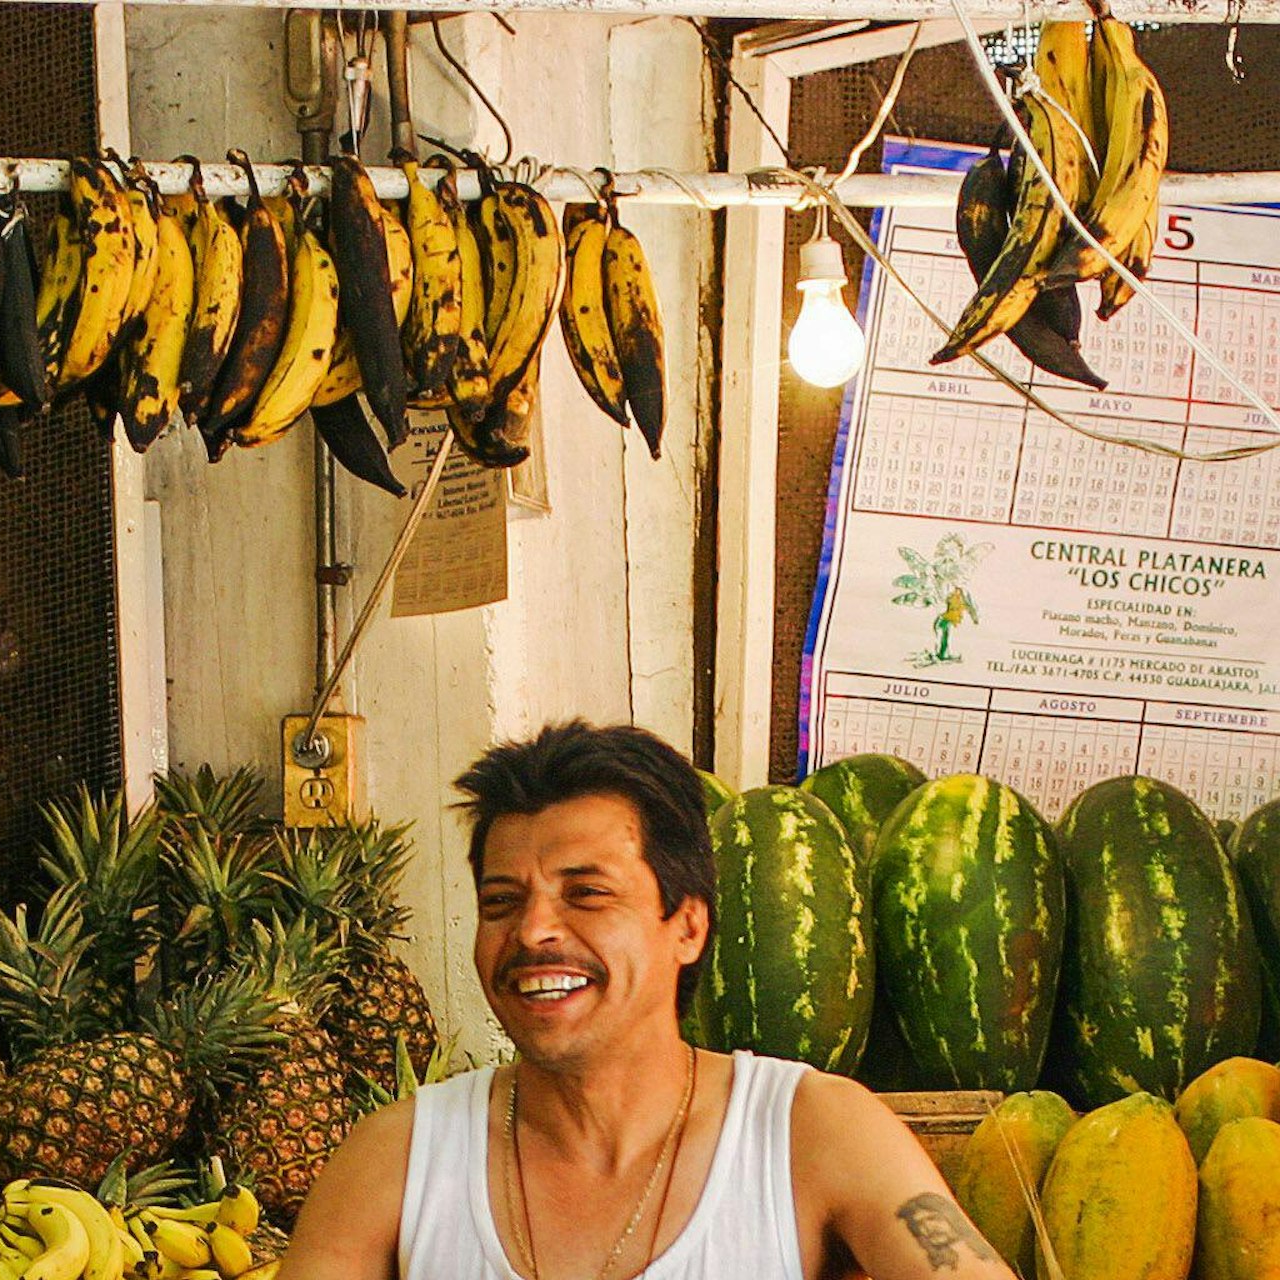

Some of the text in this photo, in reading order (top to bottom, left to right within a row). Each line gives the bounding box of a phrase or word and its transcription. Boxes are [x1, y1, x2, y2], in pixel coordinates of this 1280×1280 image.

[927, 381, 970, 394] ABRIL
[1089, 398, 1132, 412] MAYO
[1030, 541, 1267, 579] CENTRAL PLATANERA
[1087, 599, 1172, 616] ESPECIALIDAD
[1129, 658, 1186, 673] MERCADO
[1190, 662, 1203, 674] DE
[1208, 664, 1260, 679] ABASTOS
[883, 683, 930, 698] JULIO
[1039, 698, 1097, 713] AGOSTO
[1174, 708, 1270, 728] SEPTIEMBRE
